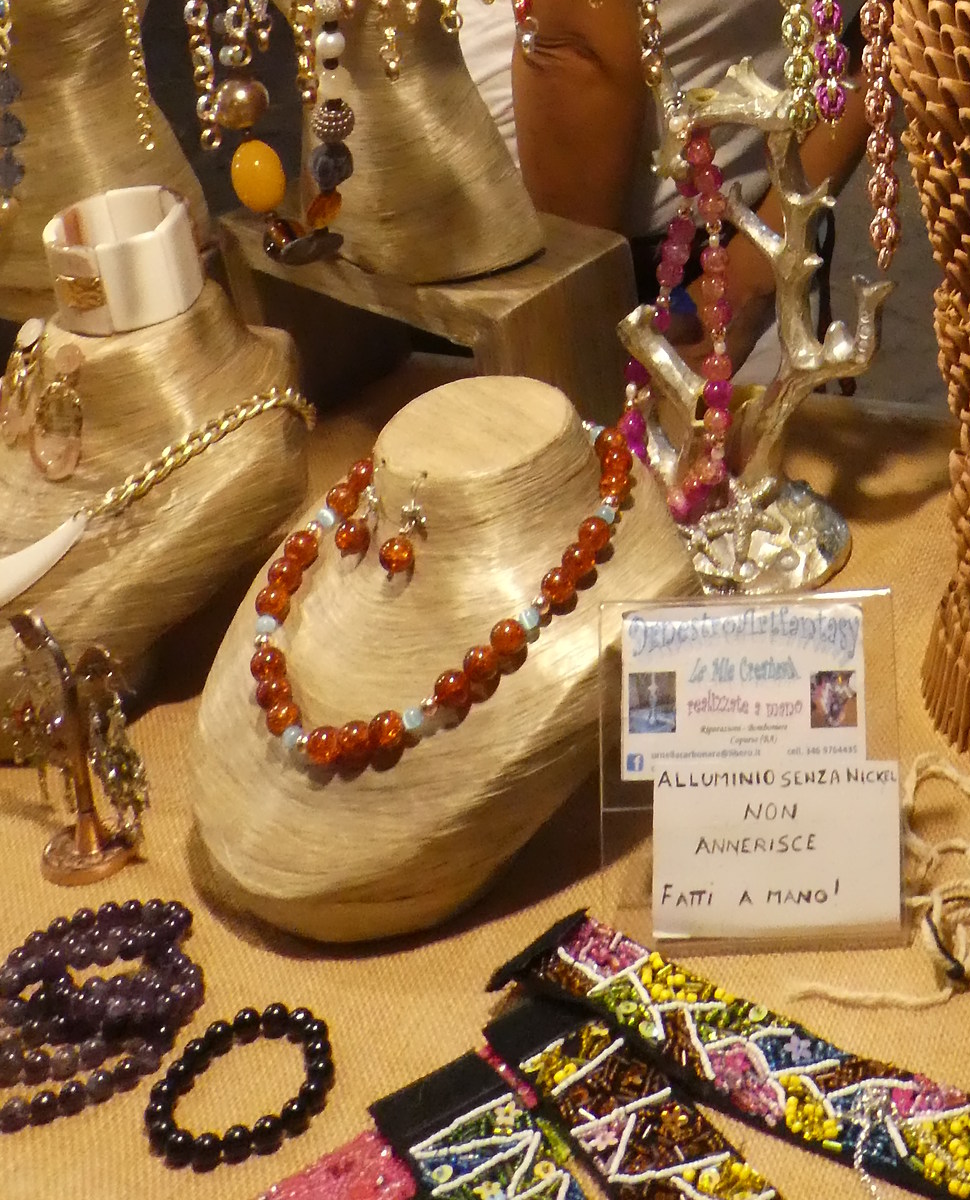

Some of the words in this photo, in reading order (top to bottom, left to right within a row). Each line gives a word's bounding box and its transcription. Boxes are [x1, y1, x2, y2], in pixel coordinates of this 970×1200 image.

[687, 689, 748, 716] realizzate
[765, 699, 802, 717] mano
[658, 770, 775, 788] ALLUMINIO
[780, 769, 841, 787] SENZA
[743, 803, 798, 820] NON
[695, 833, 817, 855] ANNERISCE
[739, 890, 753, 906] A
